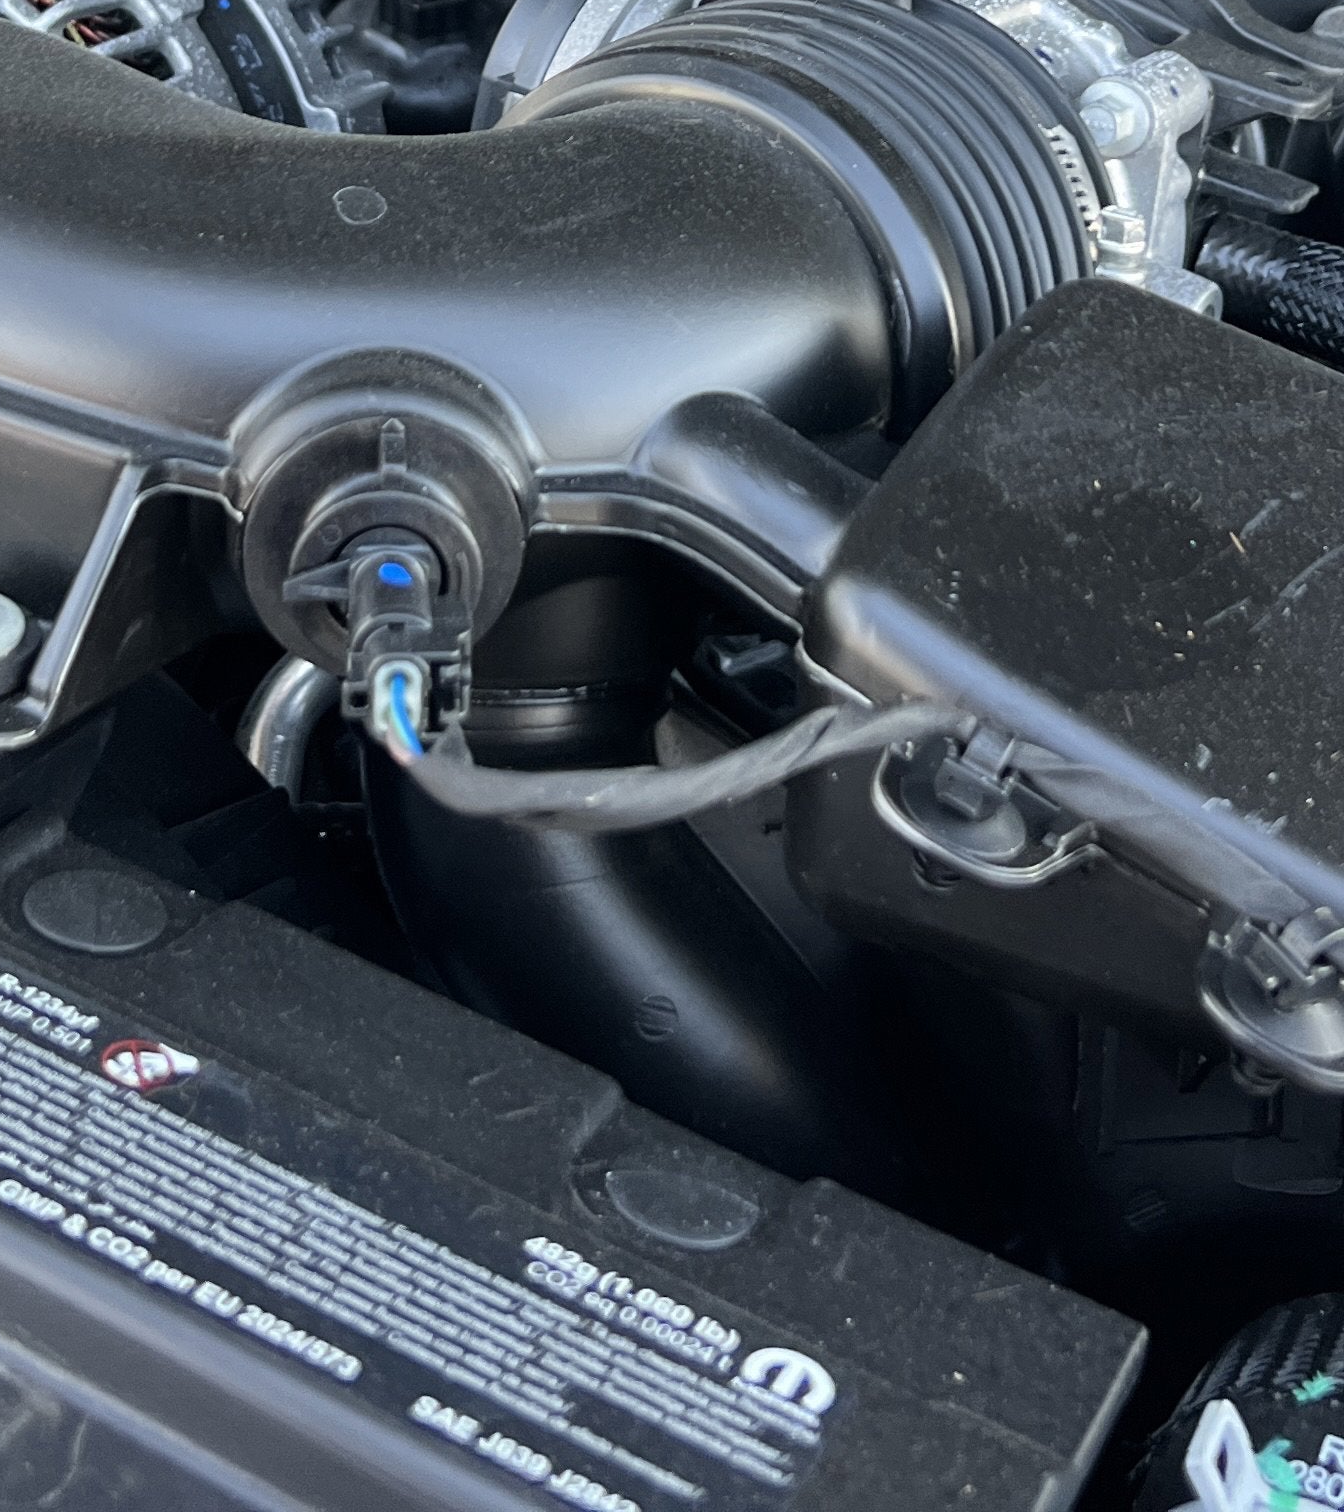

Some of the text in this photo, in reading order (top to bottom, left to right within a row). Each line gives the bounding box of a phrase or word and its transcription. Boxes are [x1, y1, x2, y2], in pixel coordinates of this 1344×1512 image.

[32, 1016, 93, 1055] 0.501
[60, 1213, 88, 1239] &
[87, 1227, 152, 1269] CO2
[143, 1260, 197, 1293] per
[193, 1281, 243, 1317] EU
[237, 1304, 363, 1380] 2024/573
[523, 1237, 600, 1286] 482g
[693, 1316, 741, 1353] lb)
[526, 1261, 583, 1300] CO2
[583, 1291, 618, 1321] eq
[410, 1395, 481, 1444] SAE
